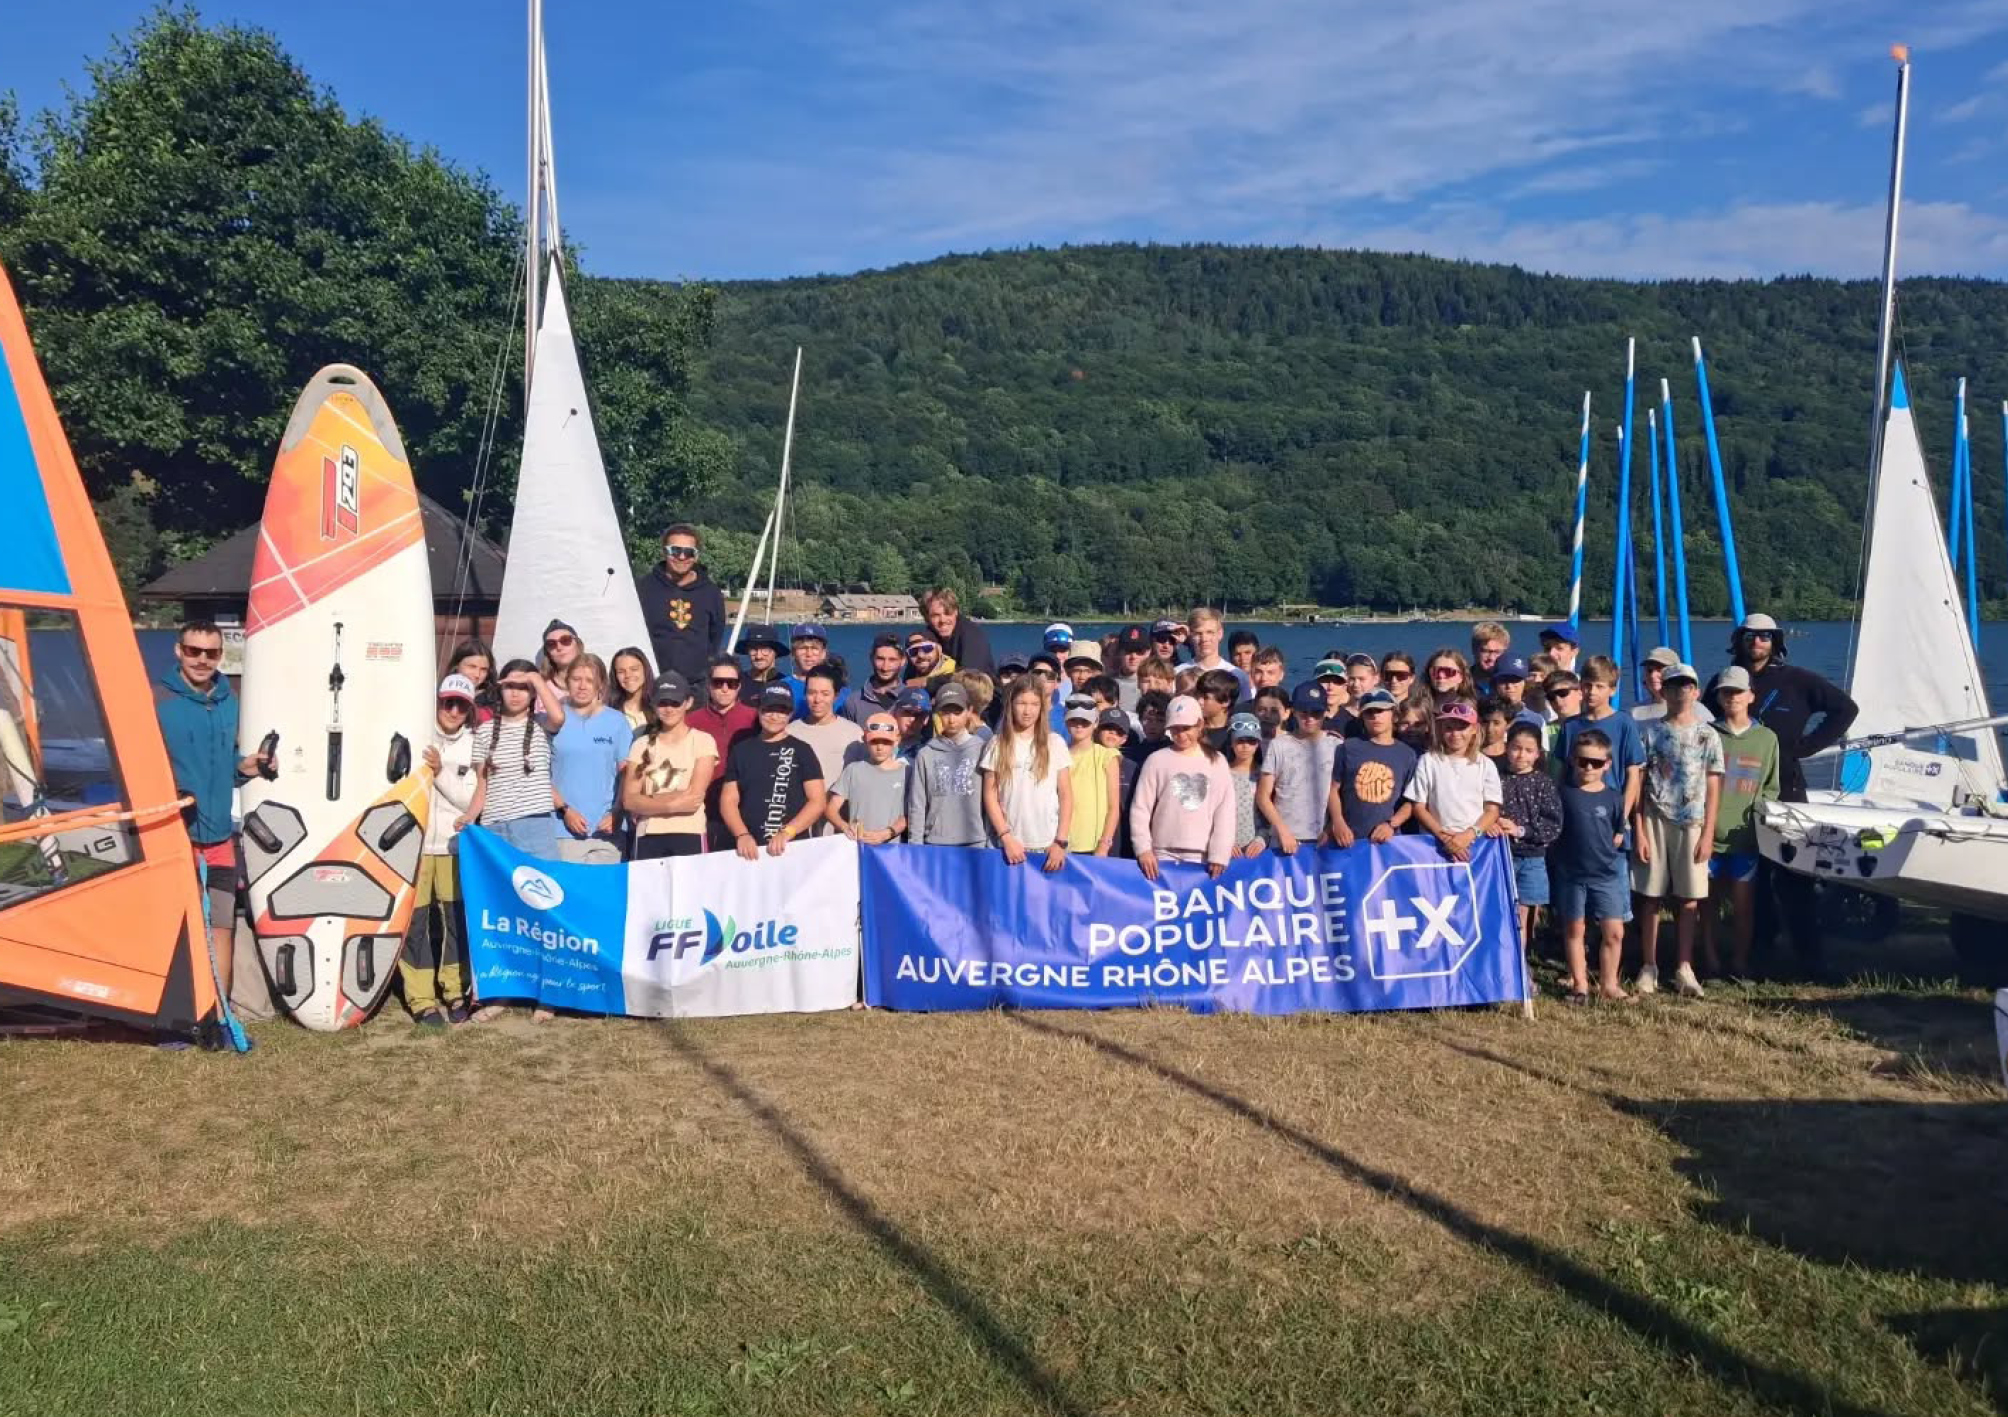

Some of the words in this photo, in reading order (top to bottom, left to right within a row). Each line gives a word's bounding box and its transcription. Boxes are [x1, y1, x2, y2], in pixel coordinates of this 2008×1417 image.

[1153, 872, 1346, 921] BANQUE
[481, 908, 511, 933] La
[516, 916, 599, 955] Région
[653, 918, 693, 932] LIGUE
[1089, 910, 1351, 956] POPULAIRE
[896, 954, 1092, 988] AUVERGNE
[1102, 958, 1231, 988] RHÔNE
[1241, 954, 1356, 985] ALPES
